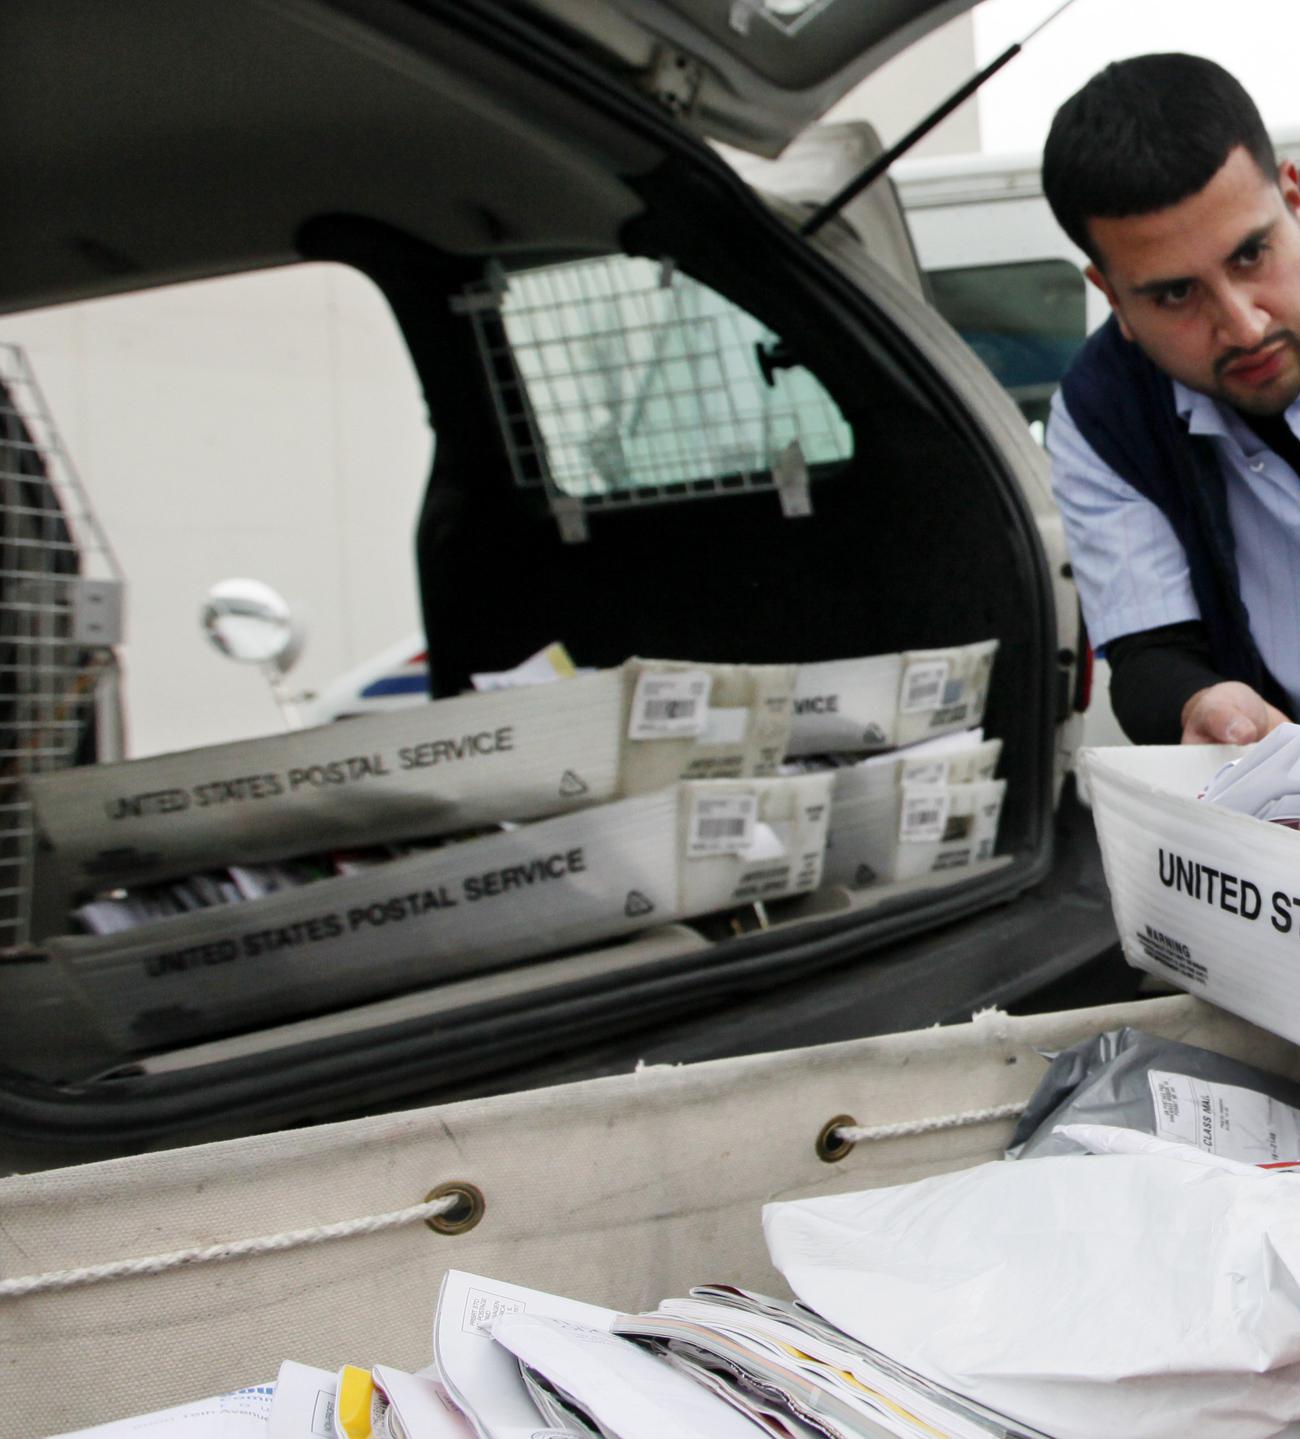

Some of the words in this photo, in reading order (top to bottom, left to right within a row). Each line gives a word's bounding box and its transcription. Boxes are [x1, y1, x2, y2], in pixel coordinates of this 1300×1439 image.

[107, 788, 191, 820] UNITED
[193, 773, 284, 808] STATES
[287, 753, 390, 792] POSTAL
[398, 726, 513, 770] SERVICE
[144, 938, 238, 978] UNITED
[242, 913, 344, 958] STATES
[347, 886, 457, 932] POSTAL
[463, 847, 586, 901] SERVICE
[1158, 848, 1261, 921] UNITED
[1145, 924, 1191, 959] WARNING
